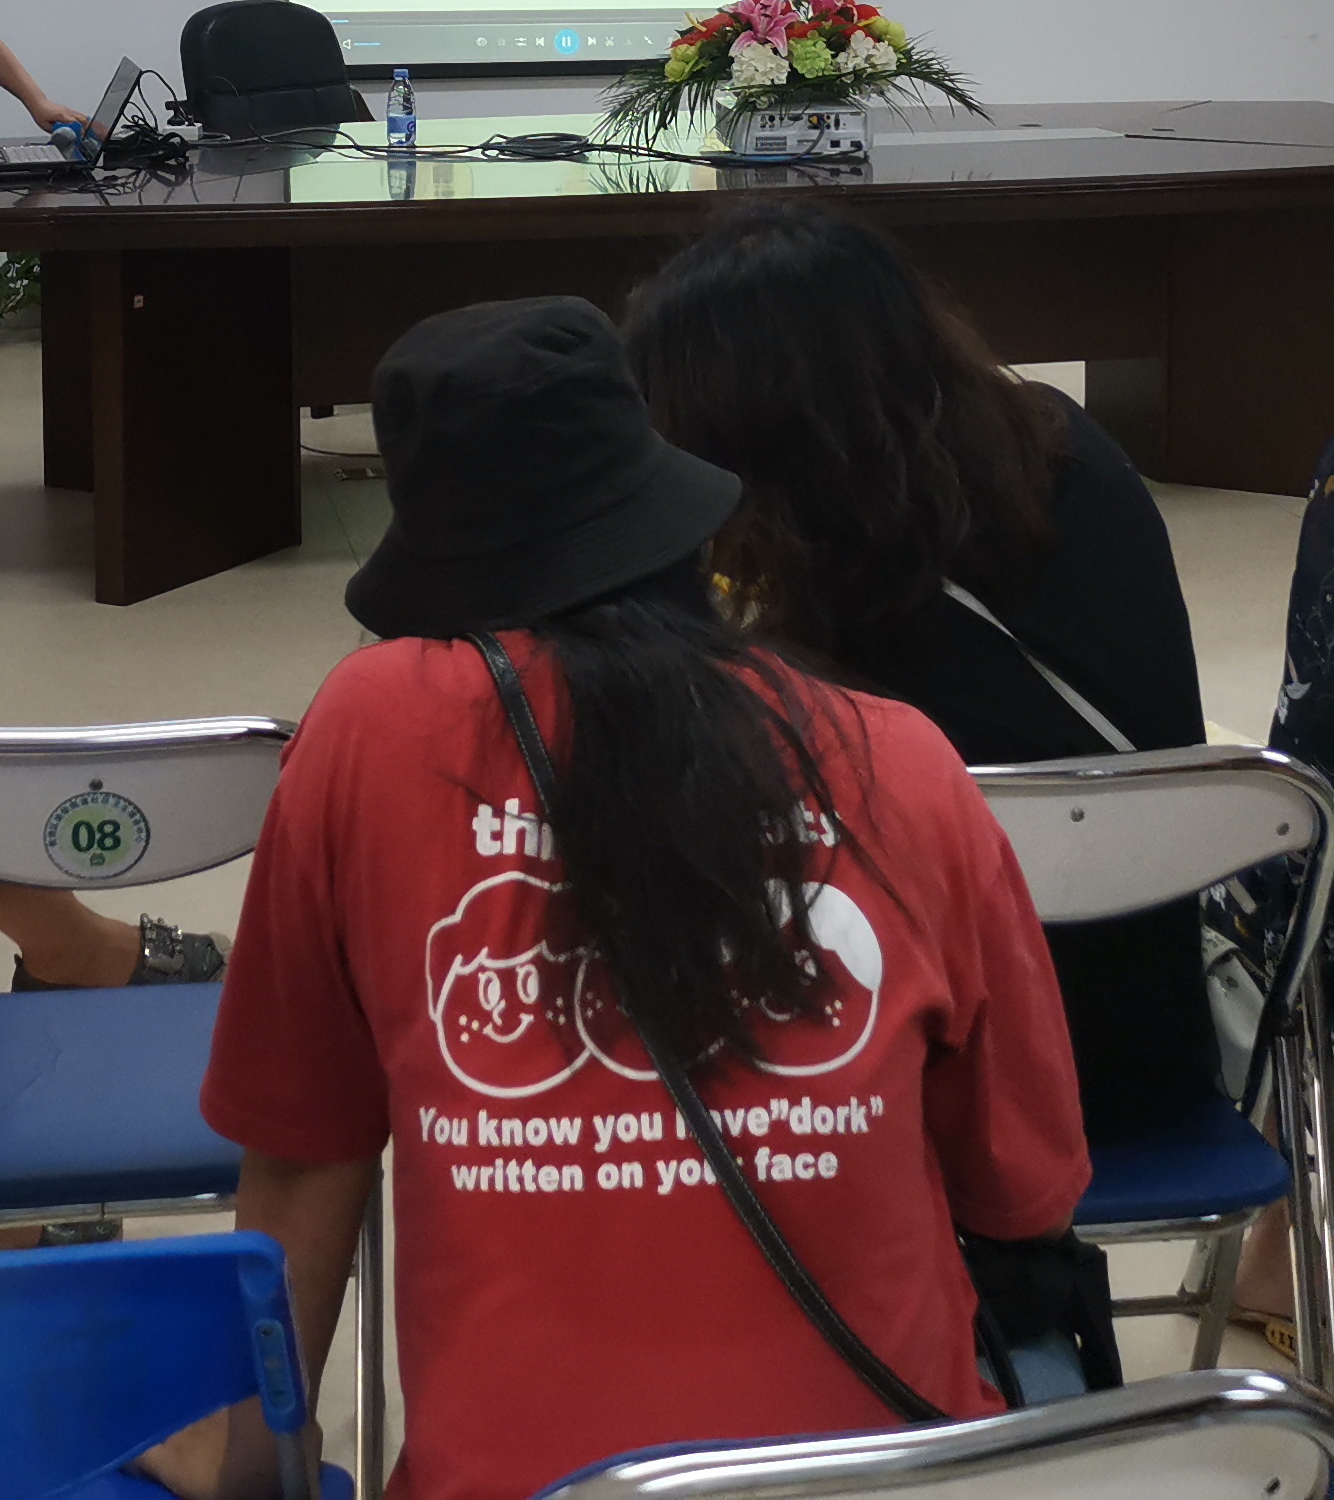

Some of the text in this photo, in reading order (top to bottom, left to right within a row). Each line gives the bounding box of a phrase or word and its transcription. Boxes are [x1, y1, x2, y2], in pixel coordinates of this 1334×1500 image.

[72, 819, 121, 852] 08
[419, 1105, 468, 1145] You
[478, 1108, 582, 1147] know
[593, 1111, 663, 1153] you
[451, 1157, 585, 1193] written
[597, 1161, 644, 1191] on
[754, 1146, 839, 1182] face
